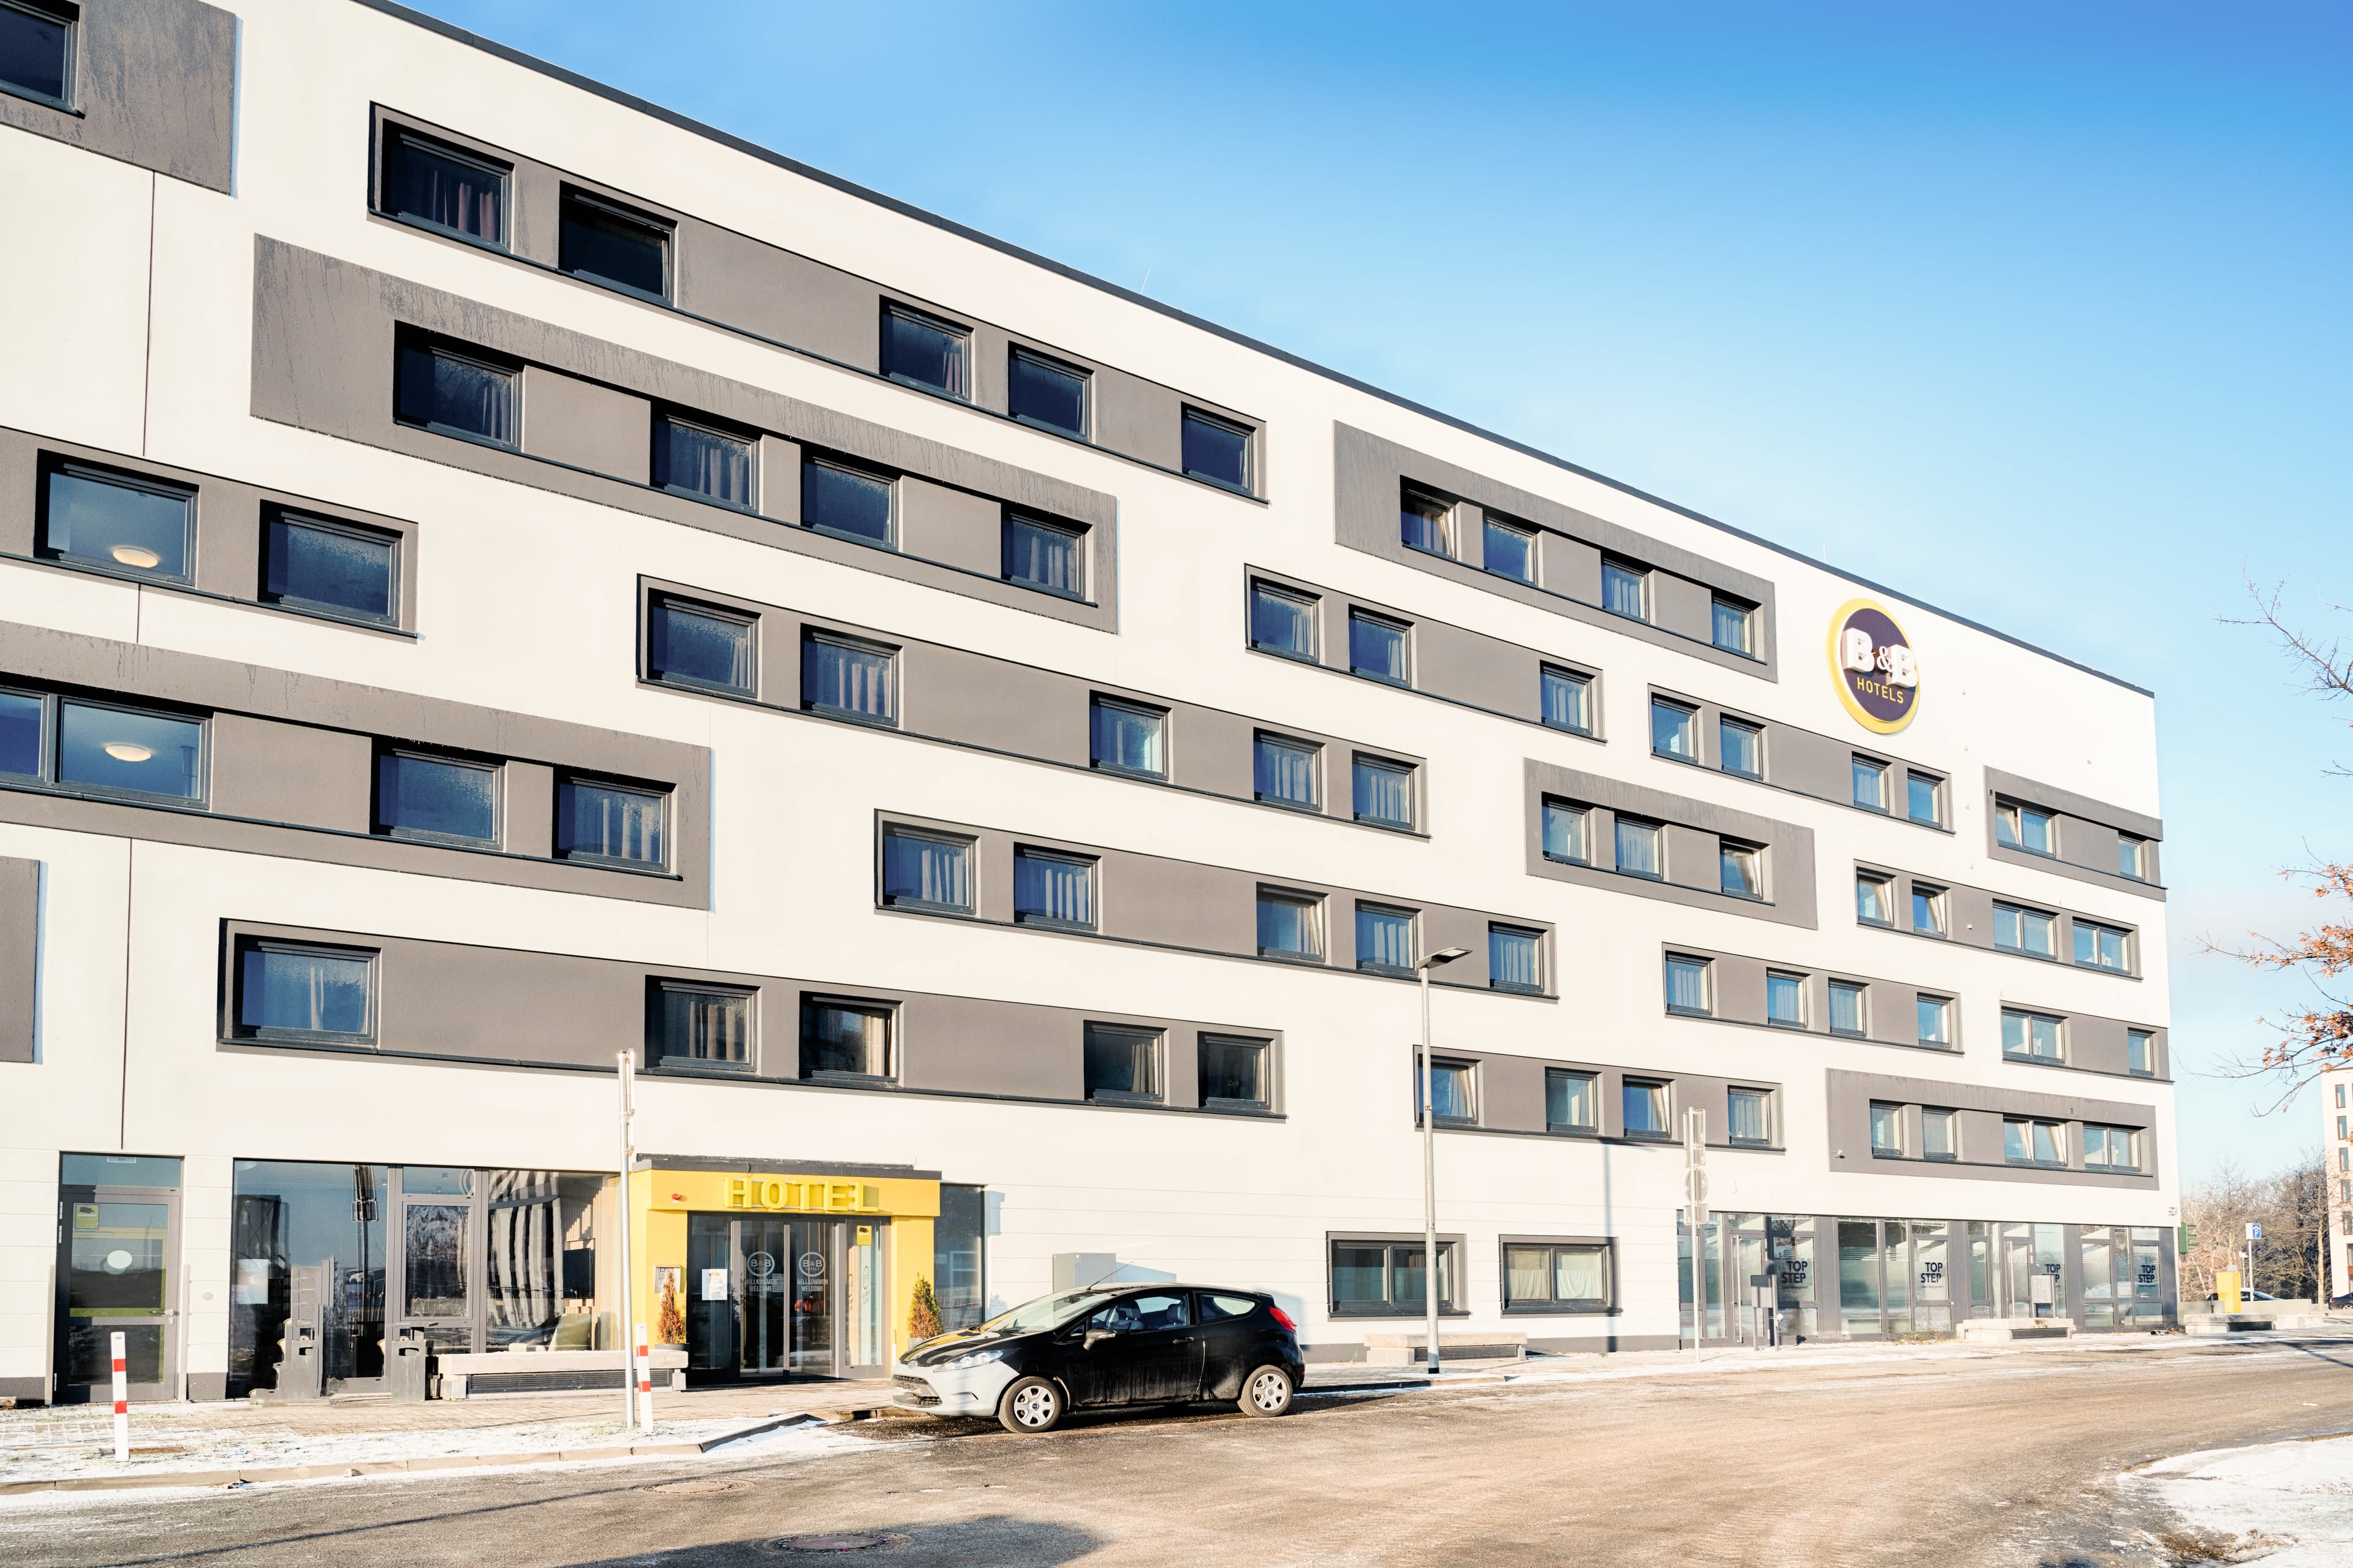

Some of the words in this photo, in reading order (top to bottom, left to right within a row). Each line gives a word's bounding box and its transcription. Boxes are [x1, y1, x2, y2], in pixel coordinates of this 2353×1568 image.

[1841, 627, 1918, 688] B&B
[1857, 676, 1904, 703] HOTELS
[726, 1177, 879, 1211] HOTEL
[1786, 1260, 1808, 1271] TOP
[1925, 1262, 1943, 1272] TOP
[2045, 1264, 2061, 1273] TOP
[2141, 1265, 2156, 1273] TOP
[1781, 1272, 1806, 1283] STEP
[1921, 1273, 1941, 1282] STEP
[2139, 1274, 2155, 1282] STEP
